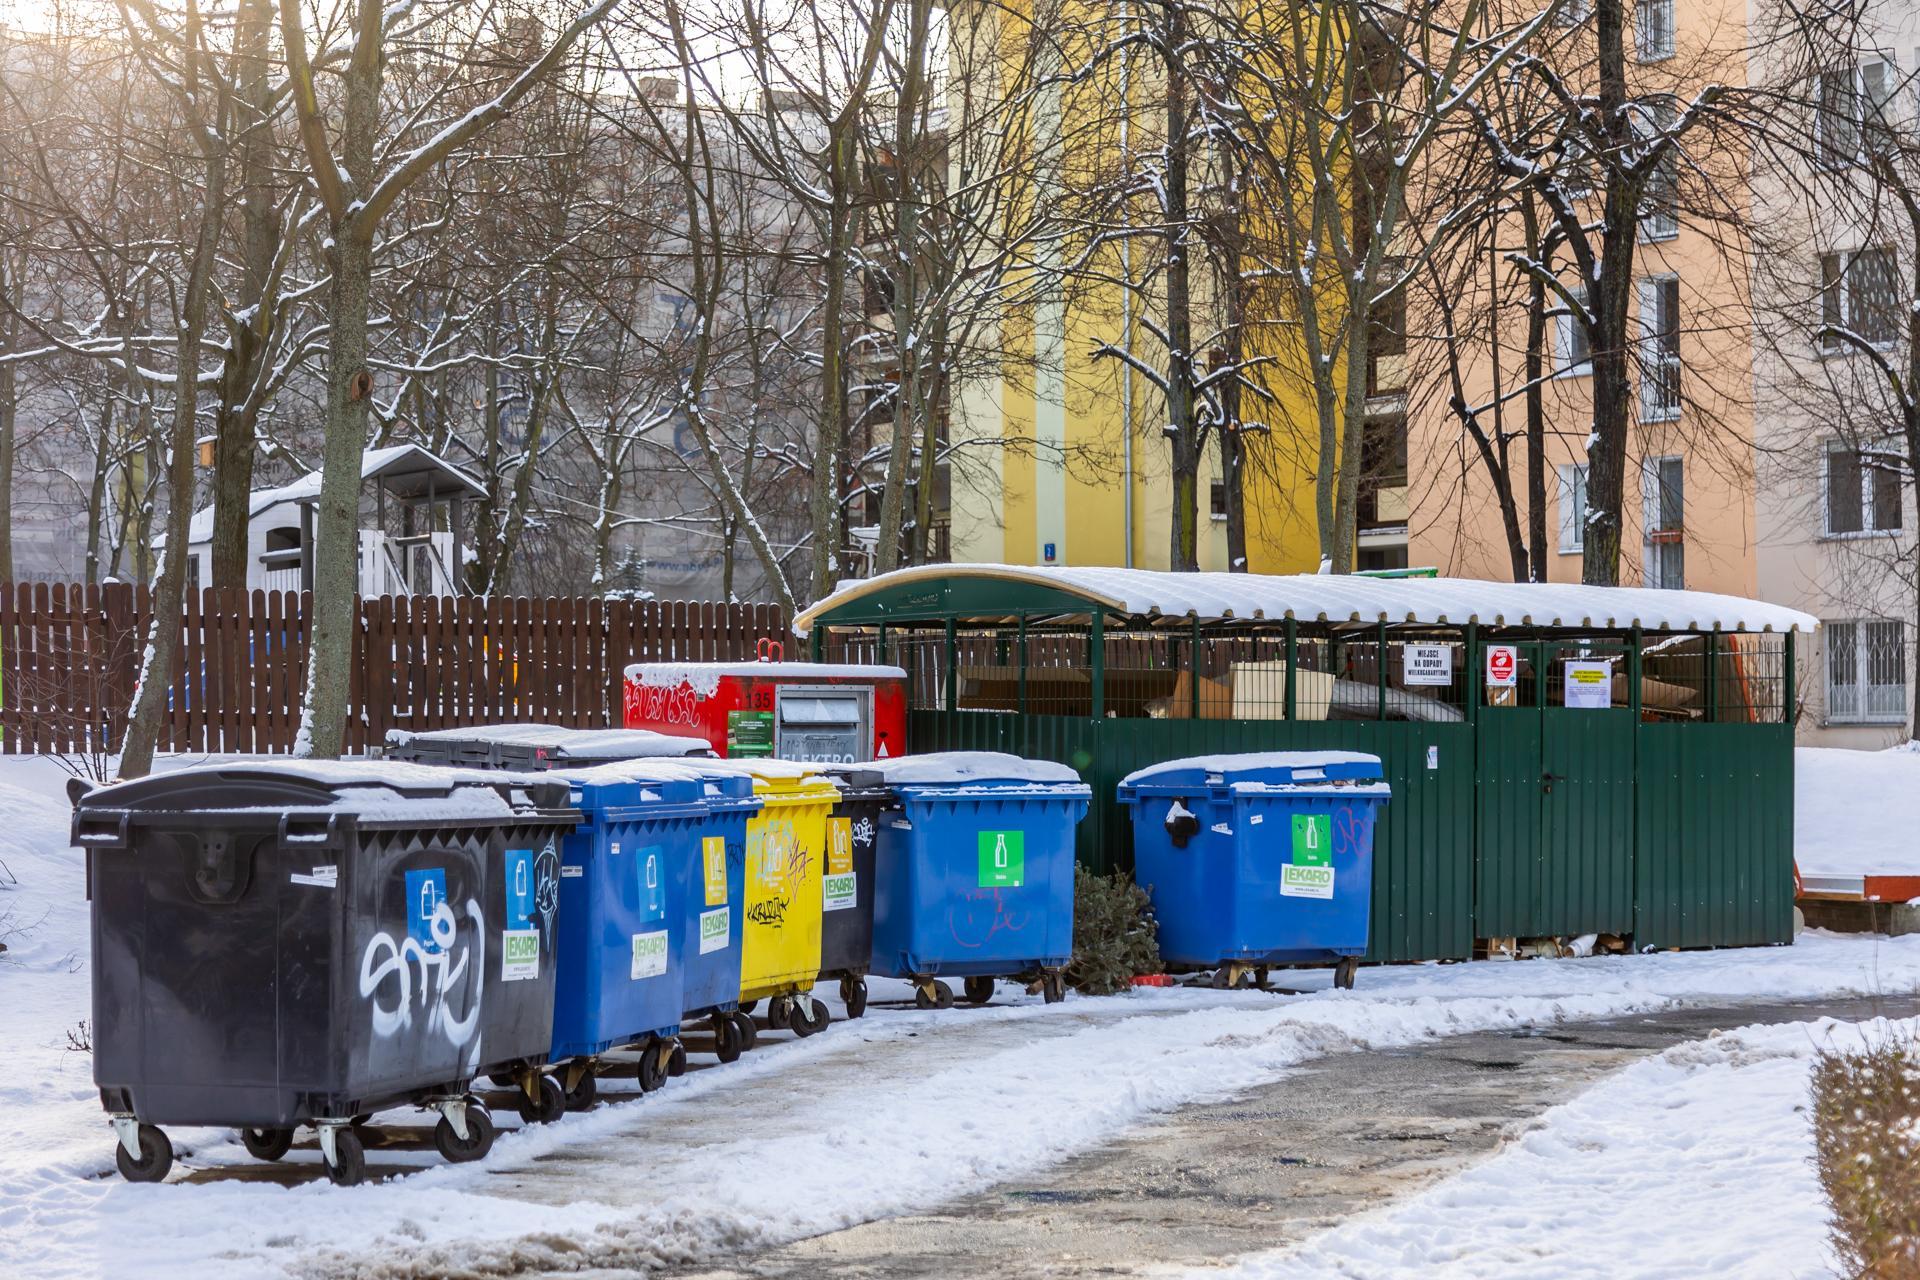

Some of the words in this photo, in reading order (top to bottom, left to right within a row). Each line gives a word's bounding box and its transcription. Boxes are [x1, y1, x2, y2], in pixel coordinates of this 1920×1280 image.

[1414, 659, 1421, 667] NA
[1422, 659, 1442, 668] ODPADY
[1417, 649, 1439, 658] MIEJSCE
[745, 692, 771, 709] 135
[825, 876, 855, 899] LEKARO
[1284, 867, 1331, 887] LEKARO
[702, 912, 728, 939] LEKARO
[505, 936, 538, 964] LEKARO
[635, 936, 667, 960] LEKARO
